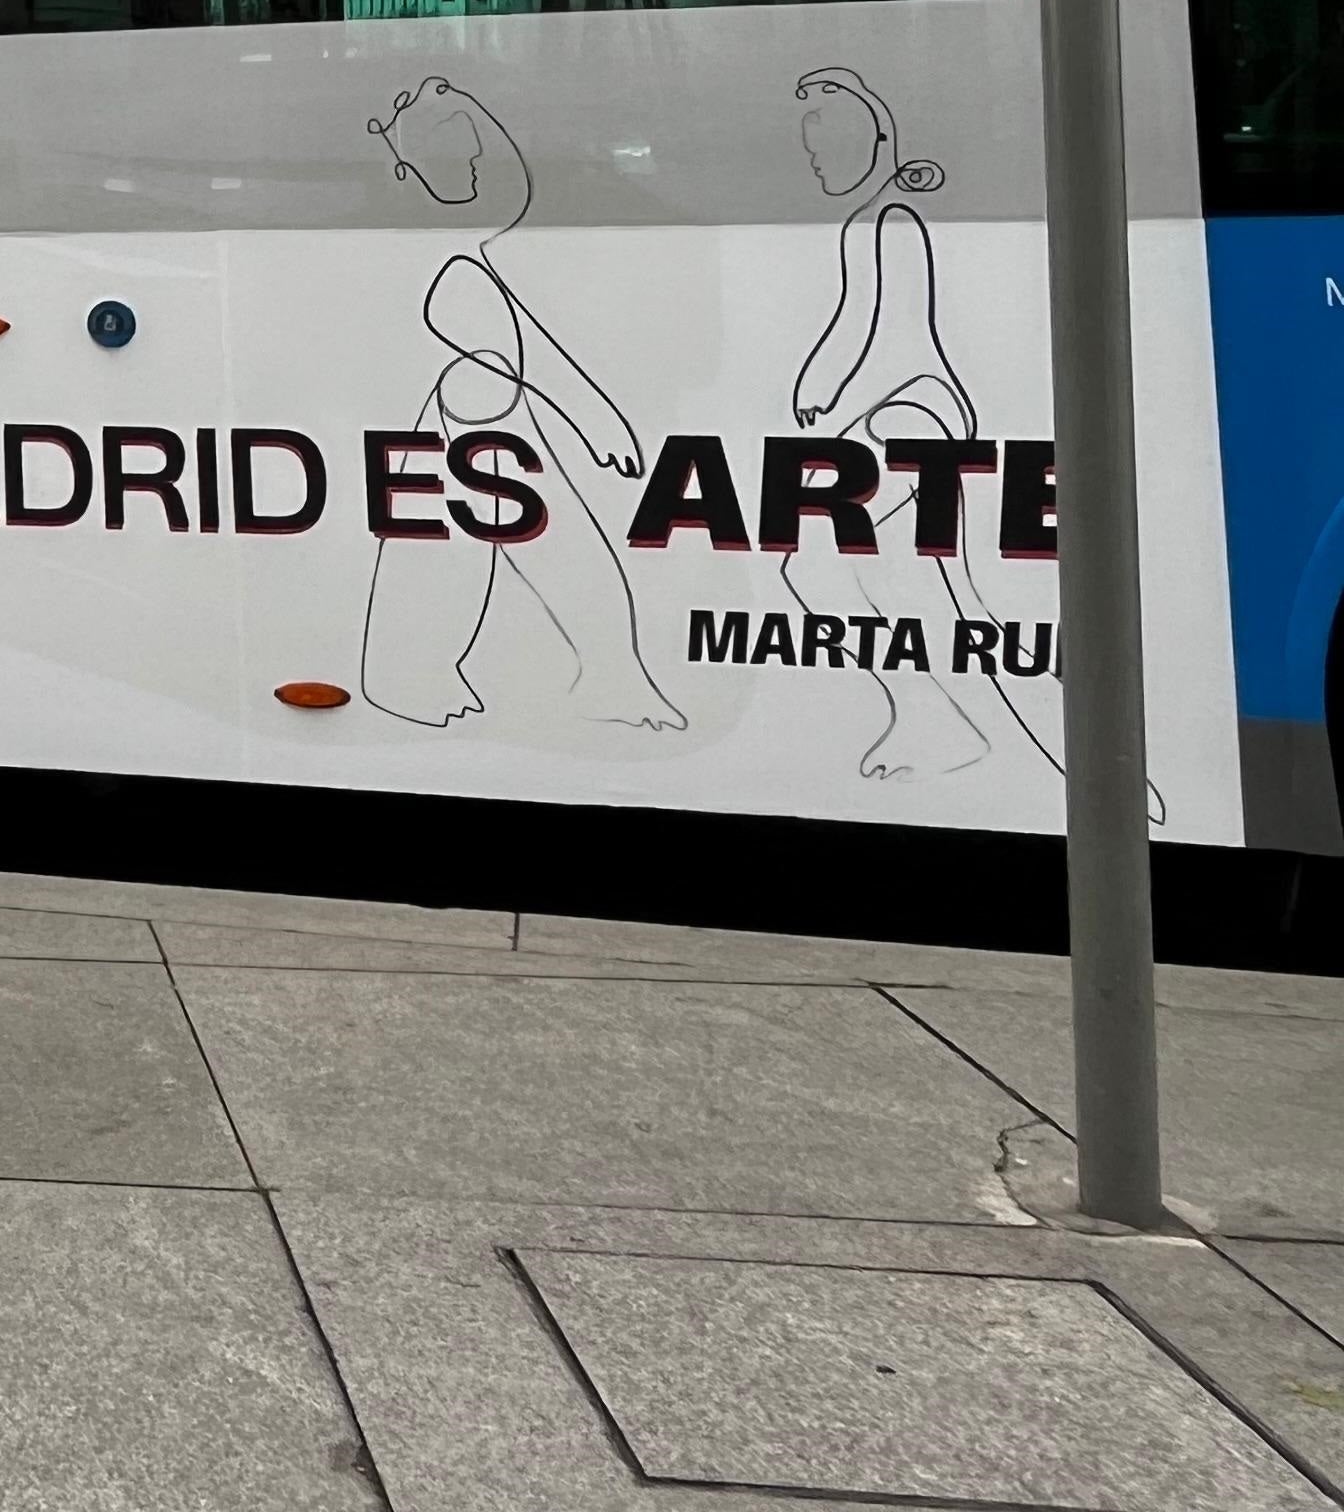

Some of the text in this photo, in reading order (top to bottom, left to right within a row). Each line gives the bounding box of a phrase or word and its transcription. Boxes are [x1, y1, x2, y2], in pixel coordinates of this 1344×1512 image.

[363, 429, 549, 544] ES
[626, 434, 1060, 560] ARTE
[688, 609, 932, 674] MARTA
